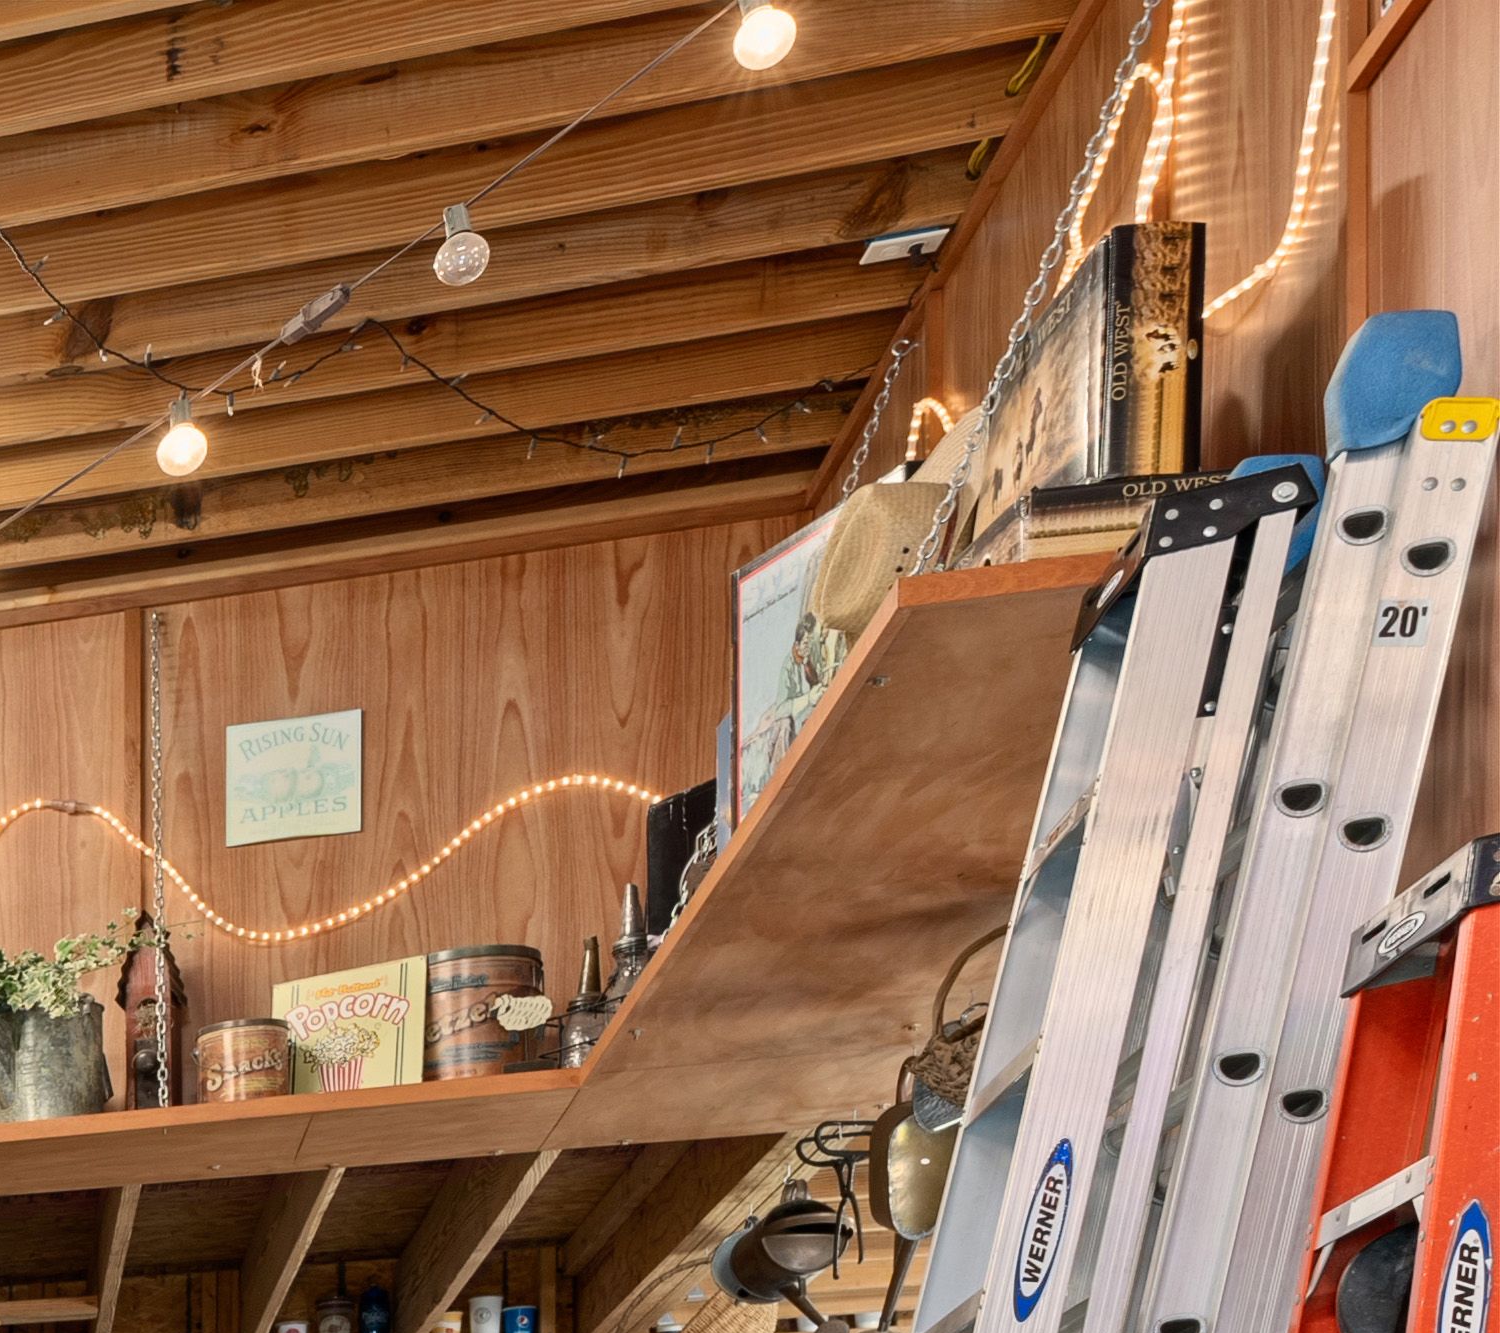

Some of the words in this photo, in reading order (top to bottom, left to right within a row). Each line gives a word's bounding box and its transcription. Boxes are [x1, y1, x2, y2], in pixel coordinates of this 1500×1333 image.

[1113, 304, 1133, 359] WEST
[1112, 364, 1128, 401] OLD
[1122, 479, 1167, 498] OLD
[1379, 605, 1428, 638] 20'
[239, 726, 305, 762] RISING
[309, 721, 351, 751] SUN
[240, 796, 348, 824] APPLES
[1022, 1174, 1064, 1284] WERNER
